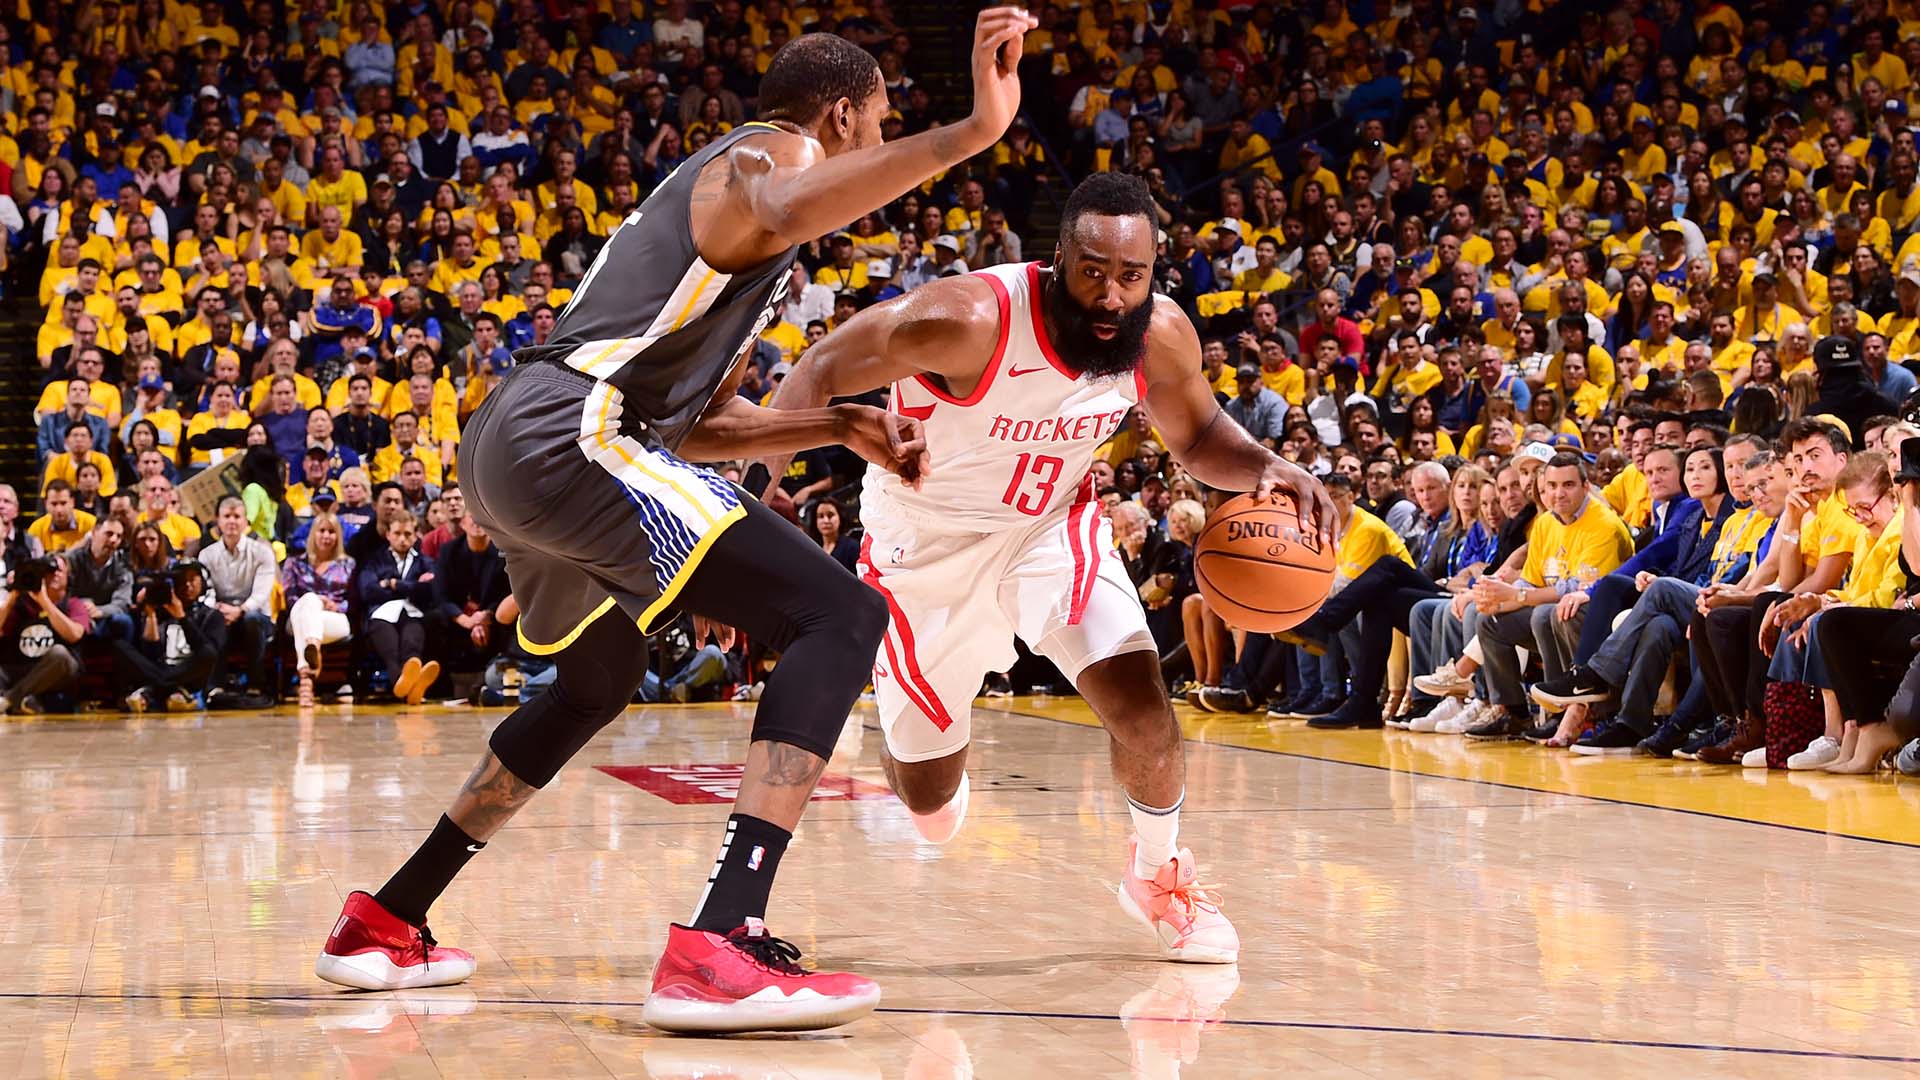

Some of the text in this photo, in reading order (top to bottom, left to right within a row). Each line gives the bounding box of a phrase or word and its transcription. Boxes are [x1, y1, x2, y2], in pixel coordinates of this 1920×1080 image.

[987, 409, 1124, 442] ROCKETS
[1002, 452, 1064, 516] 13
[1228, 520, 1321, 555] PALDING
[21, 636, 50, 648] TNT
